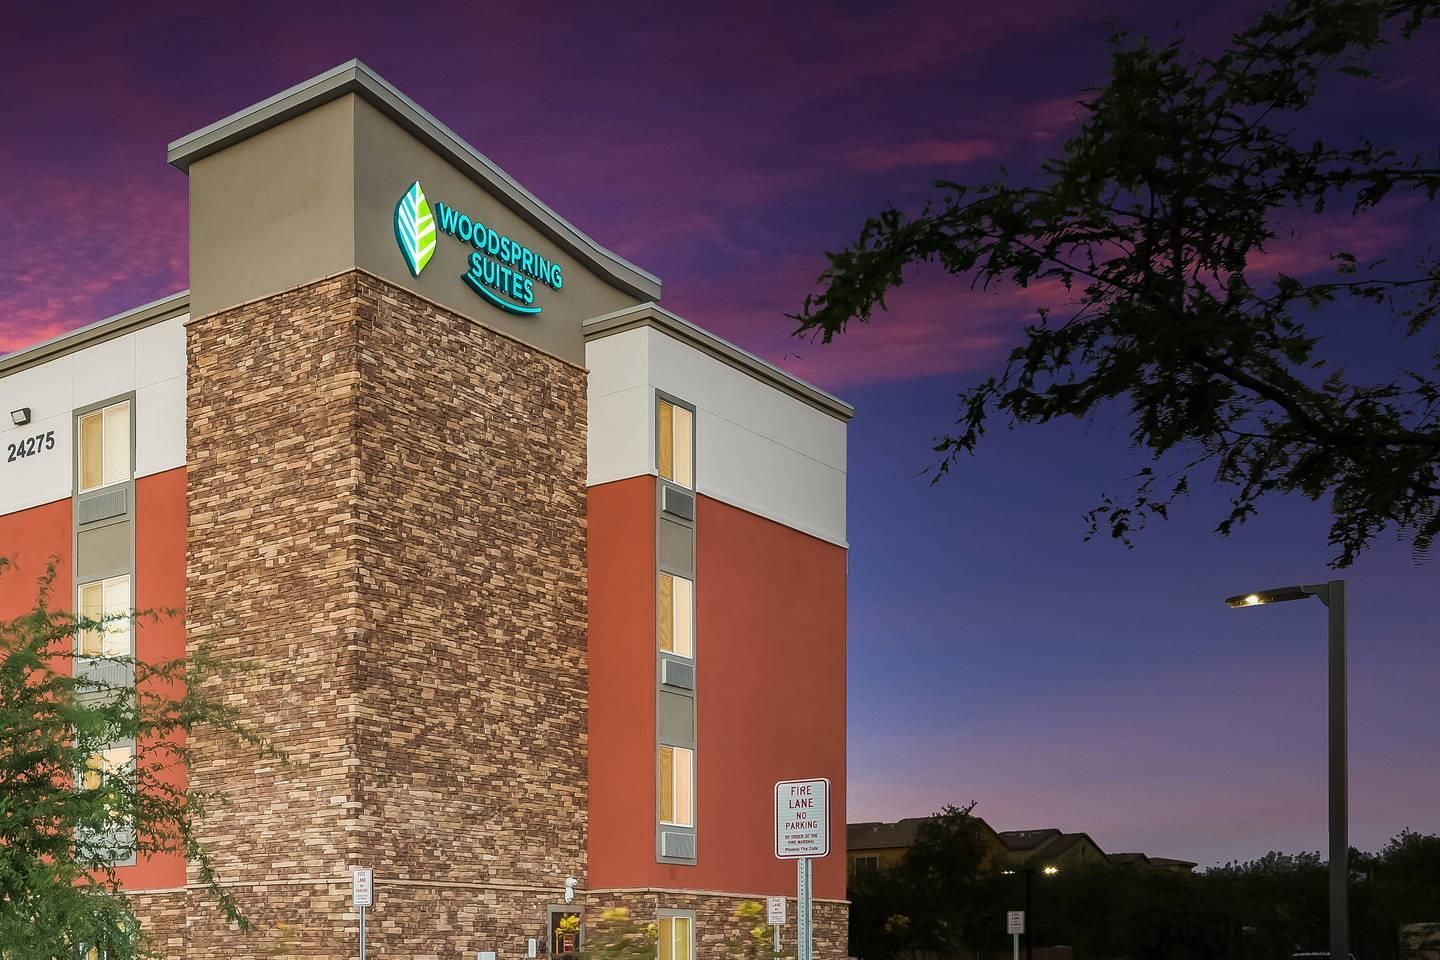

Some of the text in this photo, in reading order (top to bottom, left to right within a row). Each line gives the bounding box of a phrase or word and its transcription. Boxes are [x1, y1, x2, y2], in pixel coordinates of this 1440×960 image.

[435, 201, 563, 291] WOODSPRING
[468, 251, 534, 305] SUITES
[8, 431, 55, 462] 24275
[791, 786, 812, 796] FIRE
[789, 798, 814, 809] LANE
[786, 821, 817, 830] PARKING
